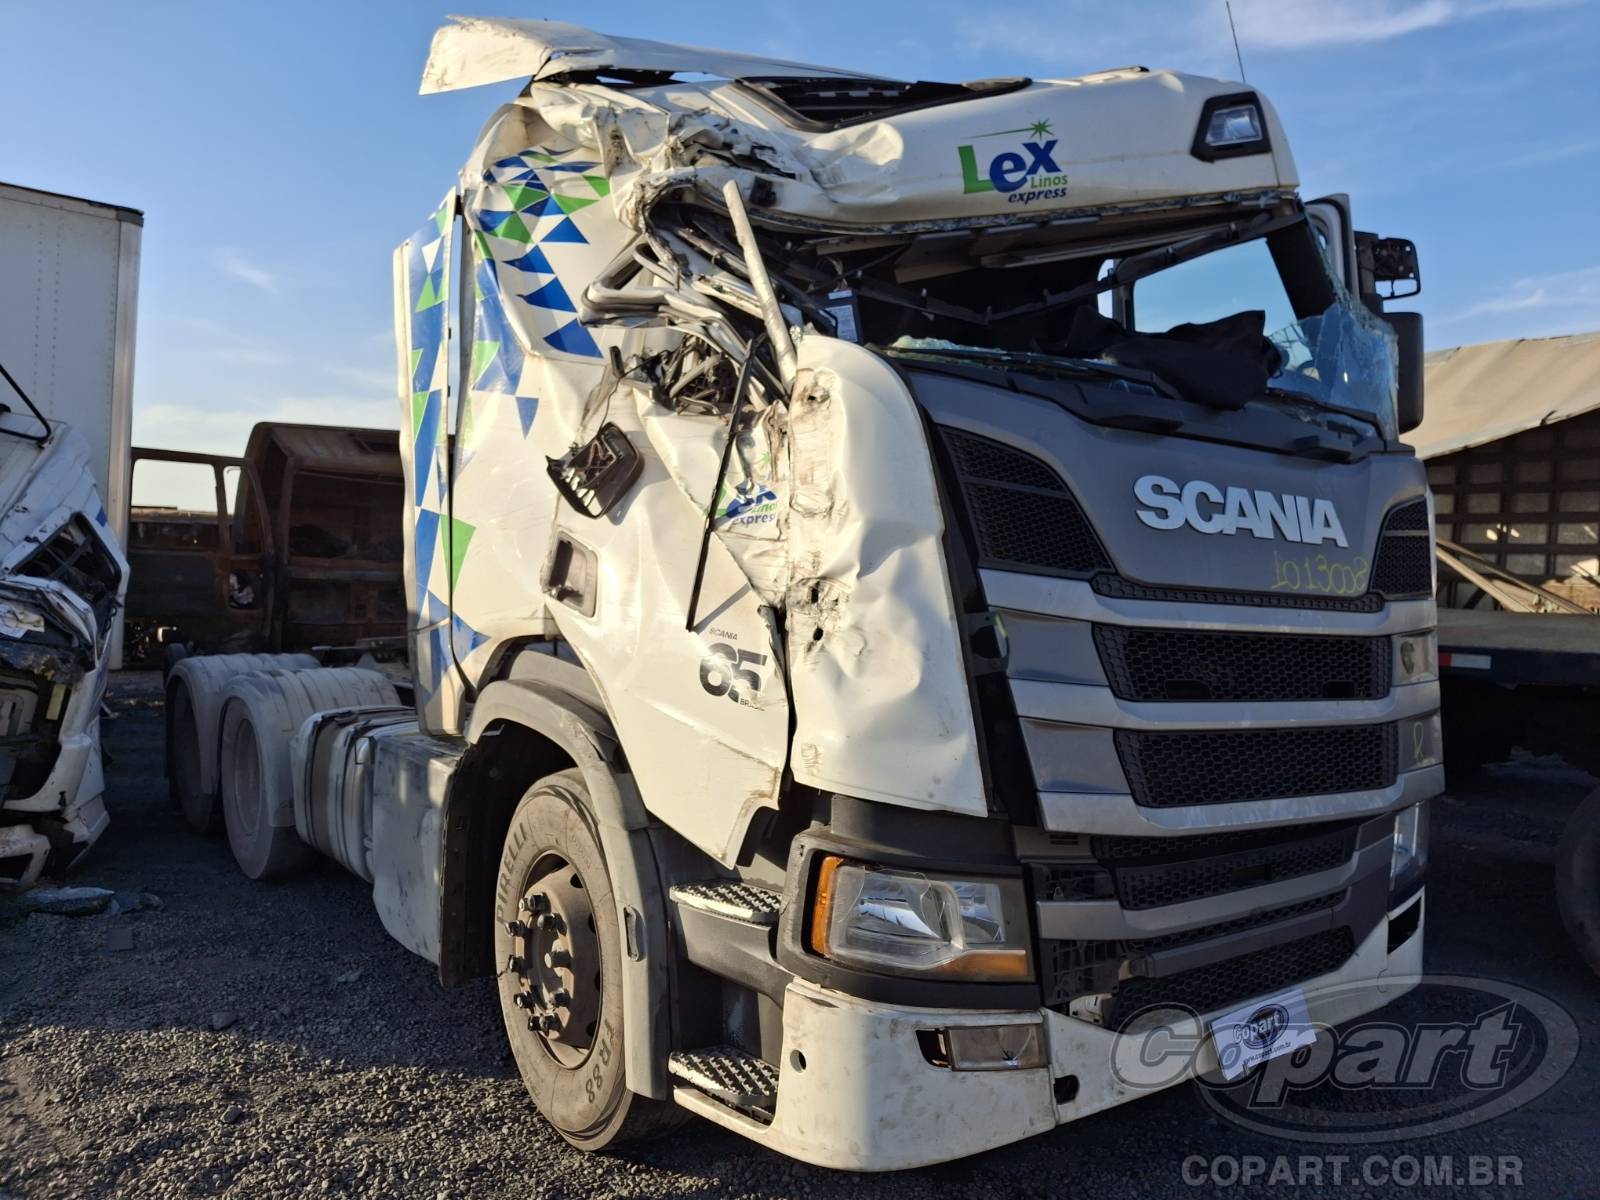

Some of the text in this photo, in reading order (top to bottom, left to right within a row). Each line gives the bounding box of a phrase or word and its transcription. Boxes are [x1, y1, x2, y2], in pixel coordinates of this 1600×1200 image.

[958, 139, 1062, 194] Lex
[1030, 174, 1068, 189] Linos
[1008, 187, 1067, 205] express
[1133, 475, 1349, 548] SCANIA
[708, 626, 738, 640] SCANIA
[496, 822, 527, 925] PIRELLI
[1233, 1011, 1281, 1043] Copart
